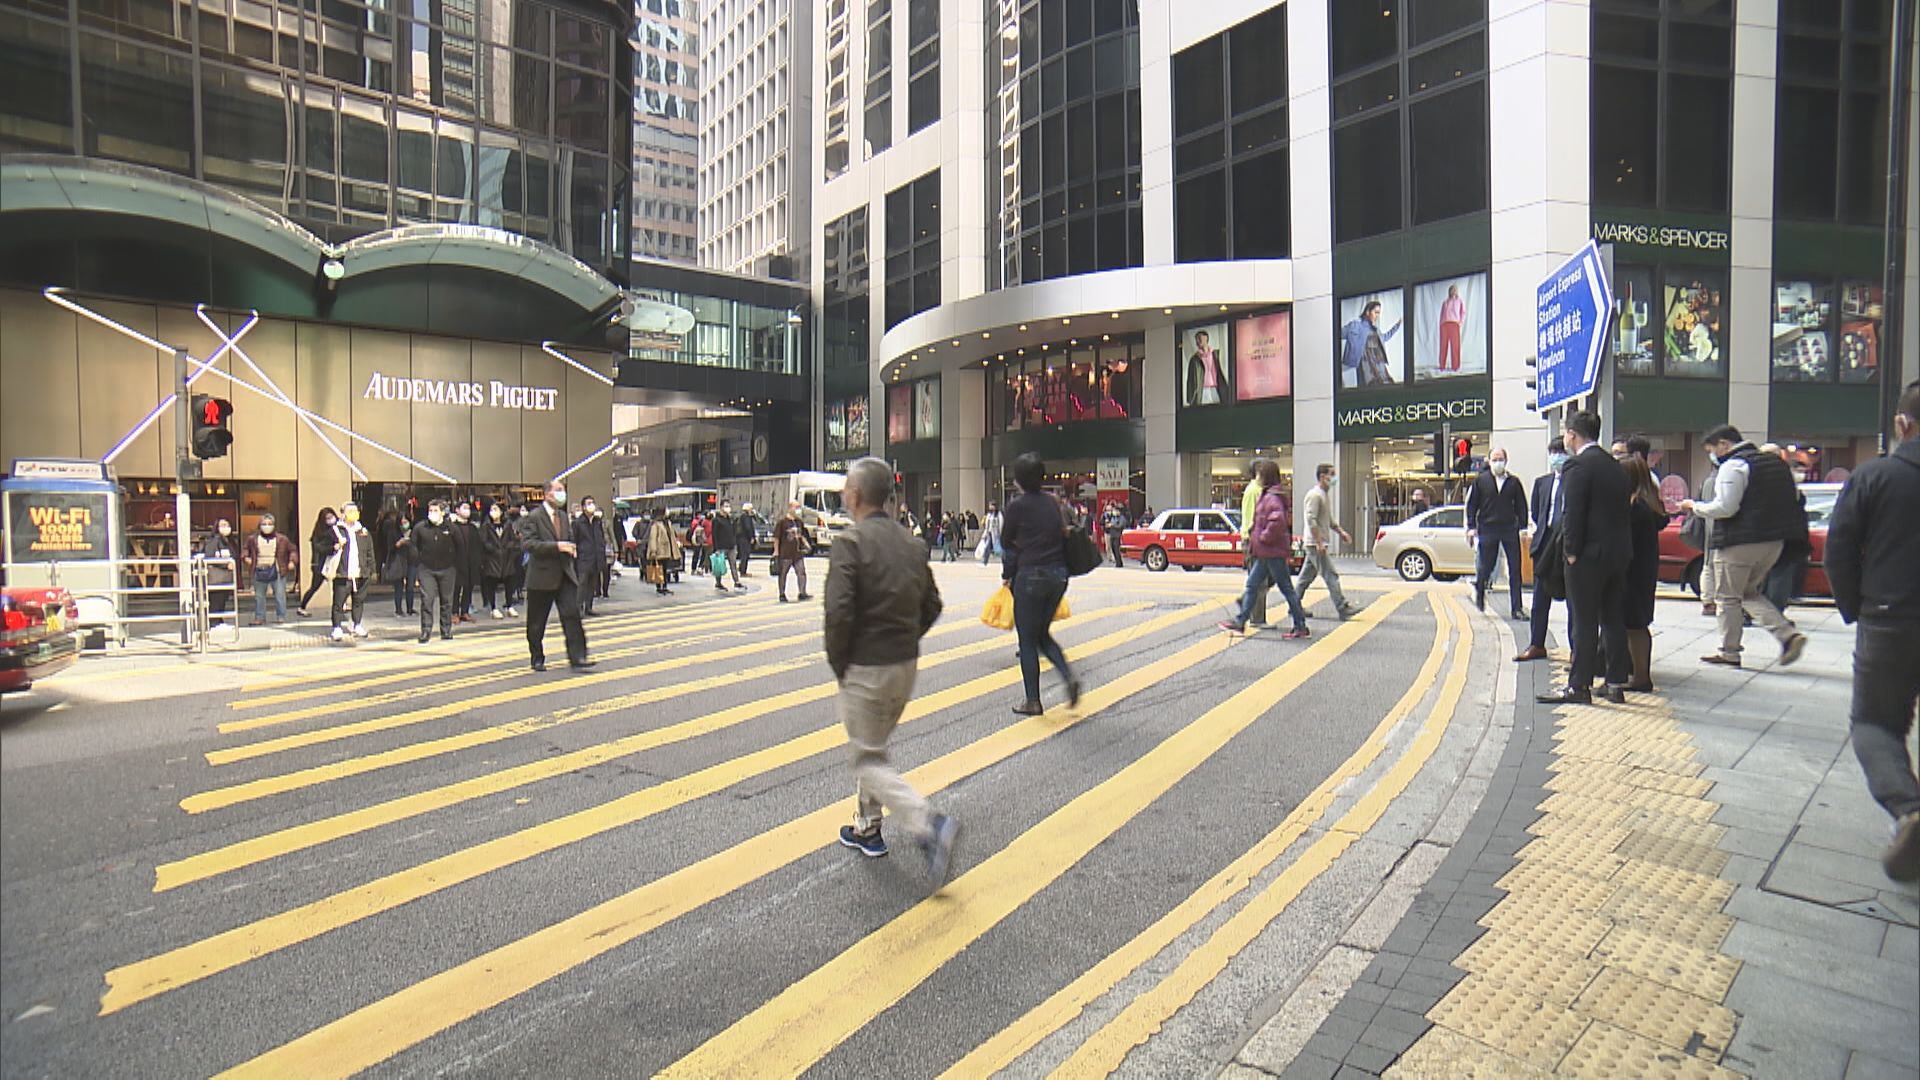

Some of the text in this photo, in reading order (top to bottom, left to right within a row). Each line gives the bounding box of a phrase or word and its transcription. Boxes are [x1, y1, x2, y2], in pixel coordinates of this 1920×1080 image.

[1539, 267, 1582, 307] Airport Express
[1539, 302, 1561, 326] Station
[1539, 348, 1566, 372] Kowloon
[363, 371, 559, 411] AUDEMARS PIGUET
[29, 506, 92, 527] Wi-Fi
[39, 523, 83, 536] 100M
